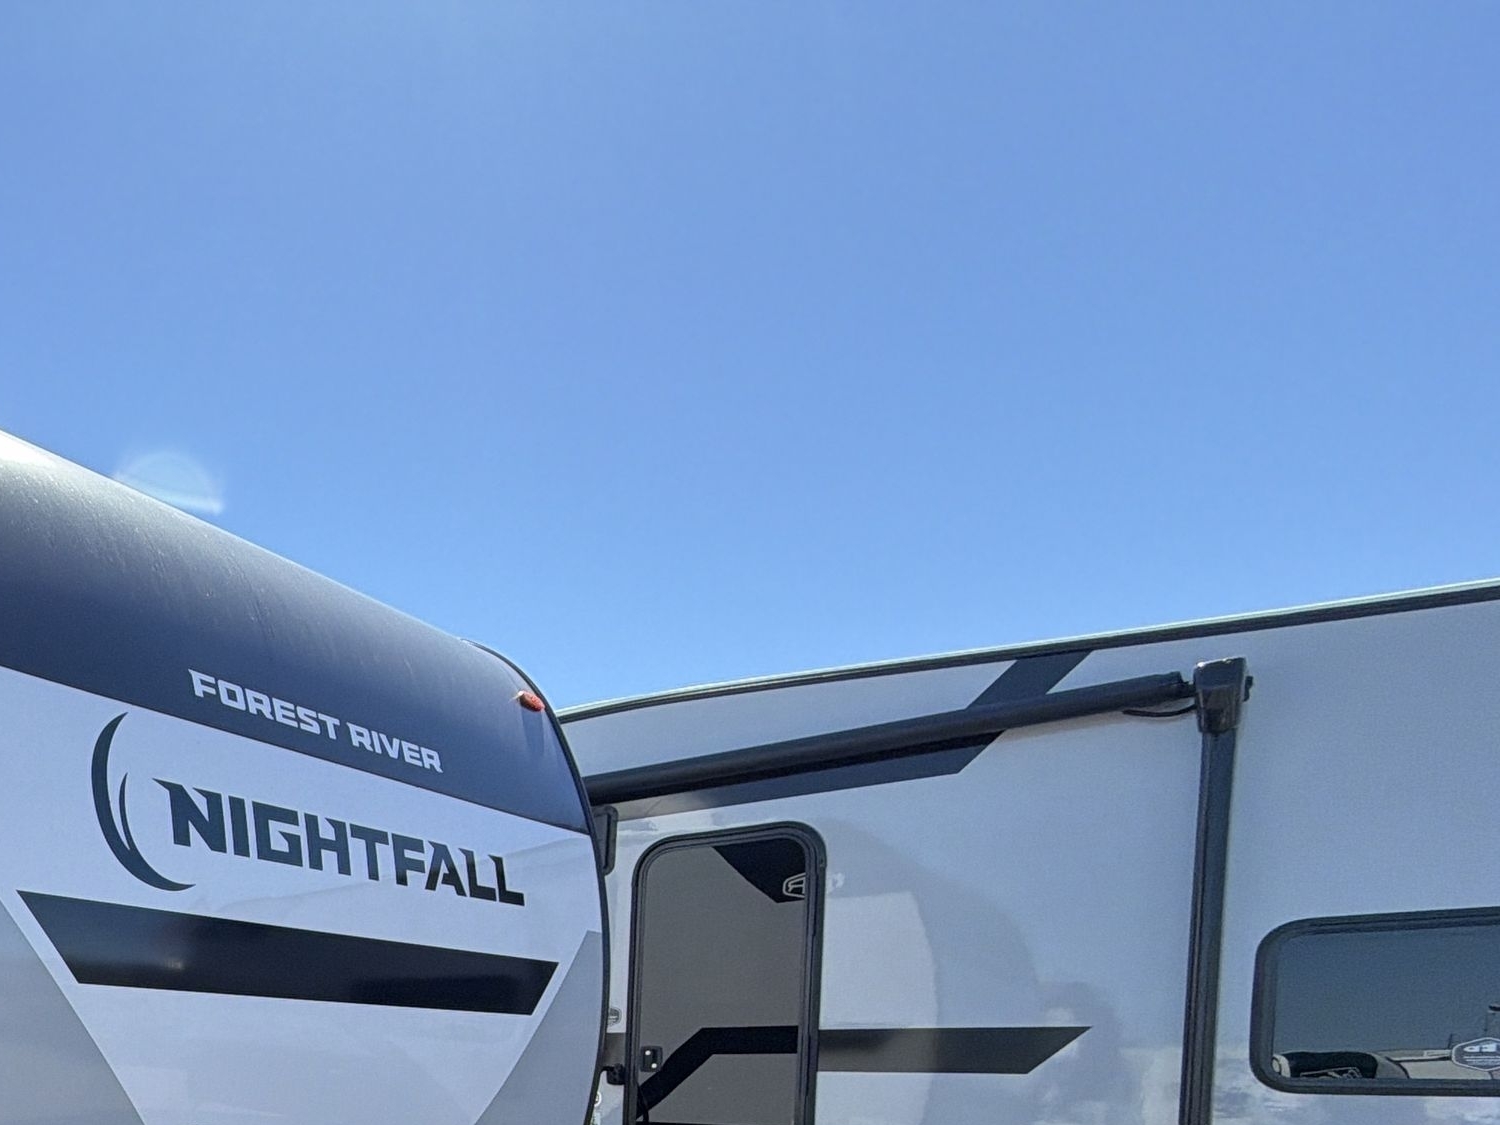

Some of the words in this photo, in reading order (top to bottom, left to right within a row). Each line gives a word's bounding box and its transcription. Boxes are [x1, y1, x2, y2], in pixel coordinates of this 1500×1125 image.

[188, 669, 340, 740] FOREST
[346, 722, 444, 773] RIVER
[152, 777, 526, 906] NIGHTFALL
